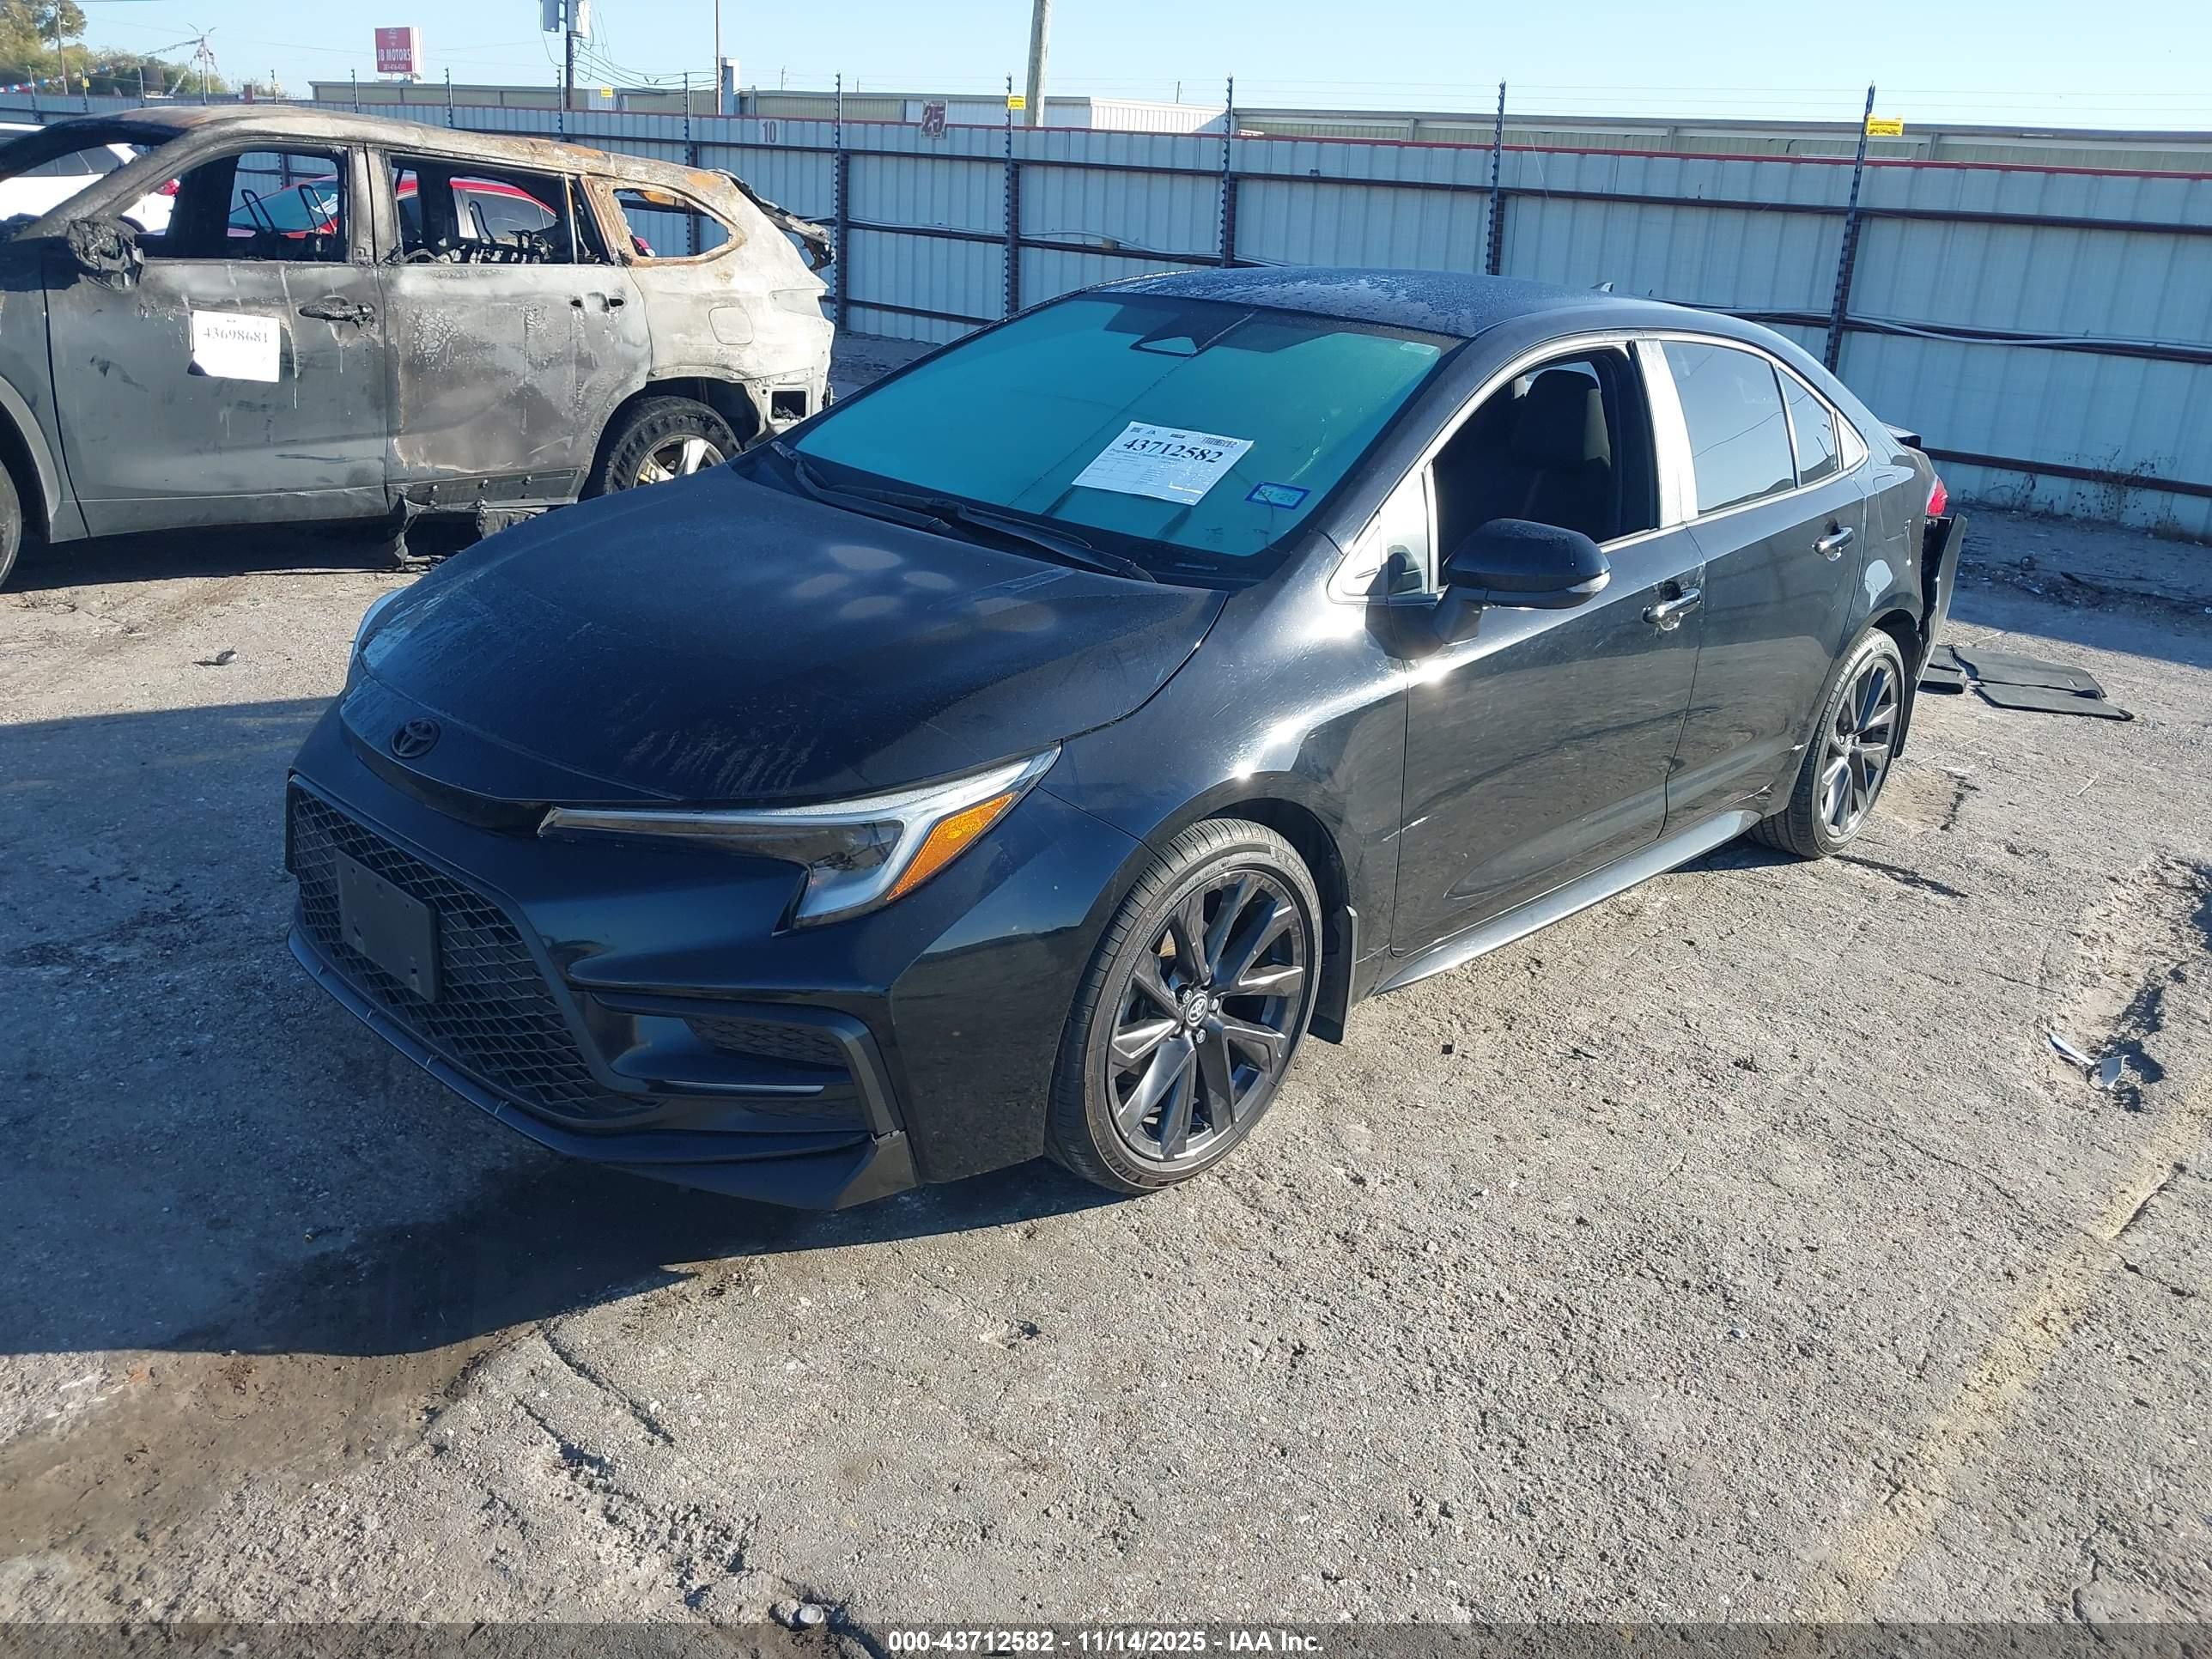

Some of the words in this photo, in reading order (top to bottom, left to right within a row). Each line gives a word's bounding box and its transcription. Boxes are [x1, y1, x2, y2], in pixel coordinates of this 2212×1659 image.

[378, 48, 385, 62] JB
[386, 48, 411, 62] MOTORS
[922, 104, 945, 133] 25
[763, 120, 776, 143] 10
[203, 326, 268, 343] 43698681
[1122, 438, 1224, 464] 43712582
